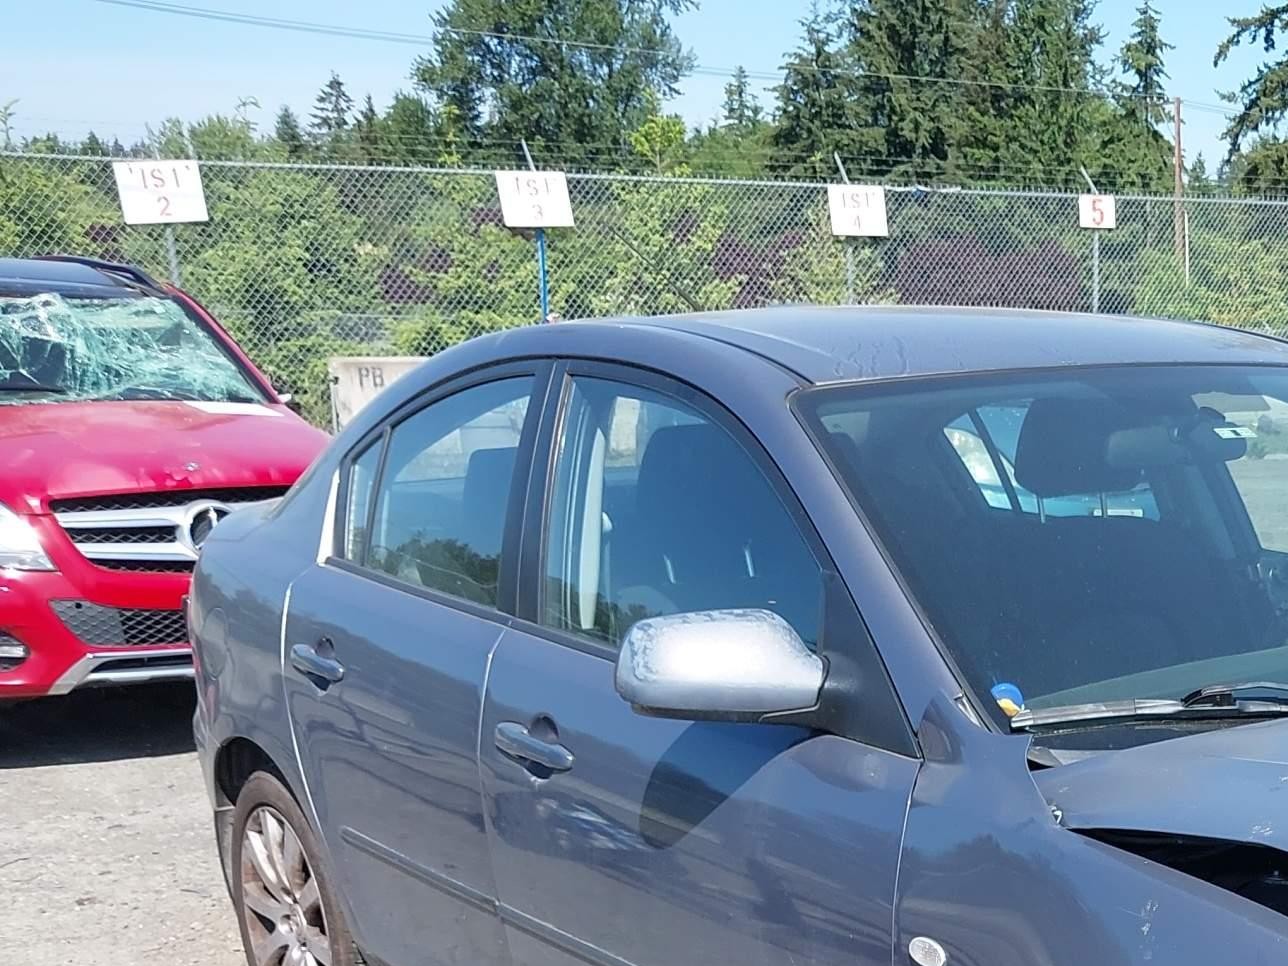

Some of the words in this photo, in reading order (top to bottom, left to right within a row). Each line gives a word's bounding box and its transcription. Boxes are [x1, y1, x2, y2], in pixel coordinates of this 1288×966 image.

[157, 195, 173, 217] 2
[1092, 198, 1105, 227] 5
[358, 366, 385, 390] PB
